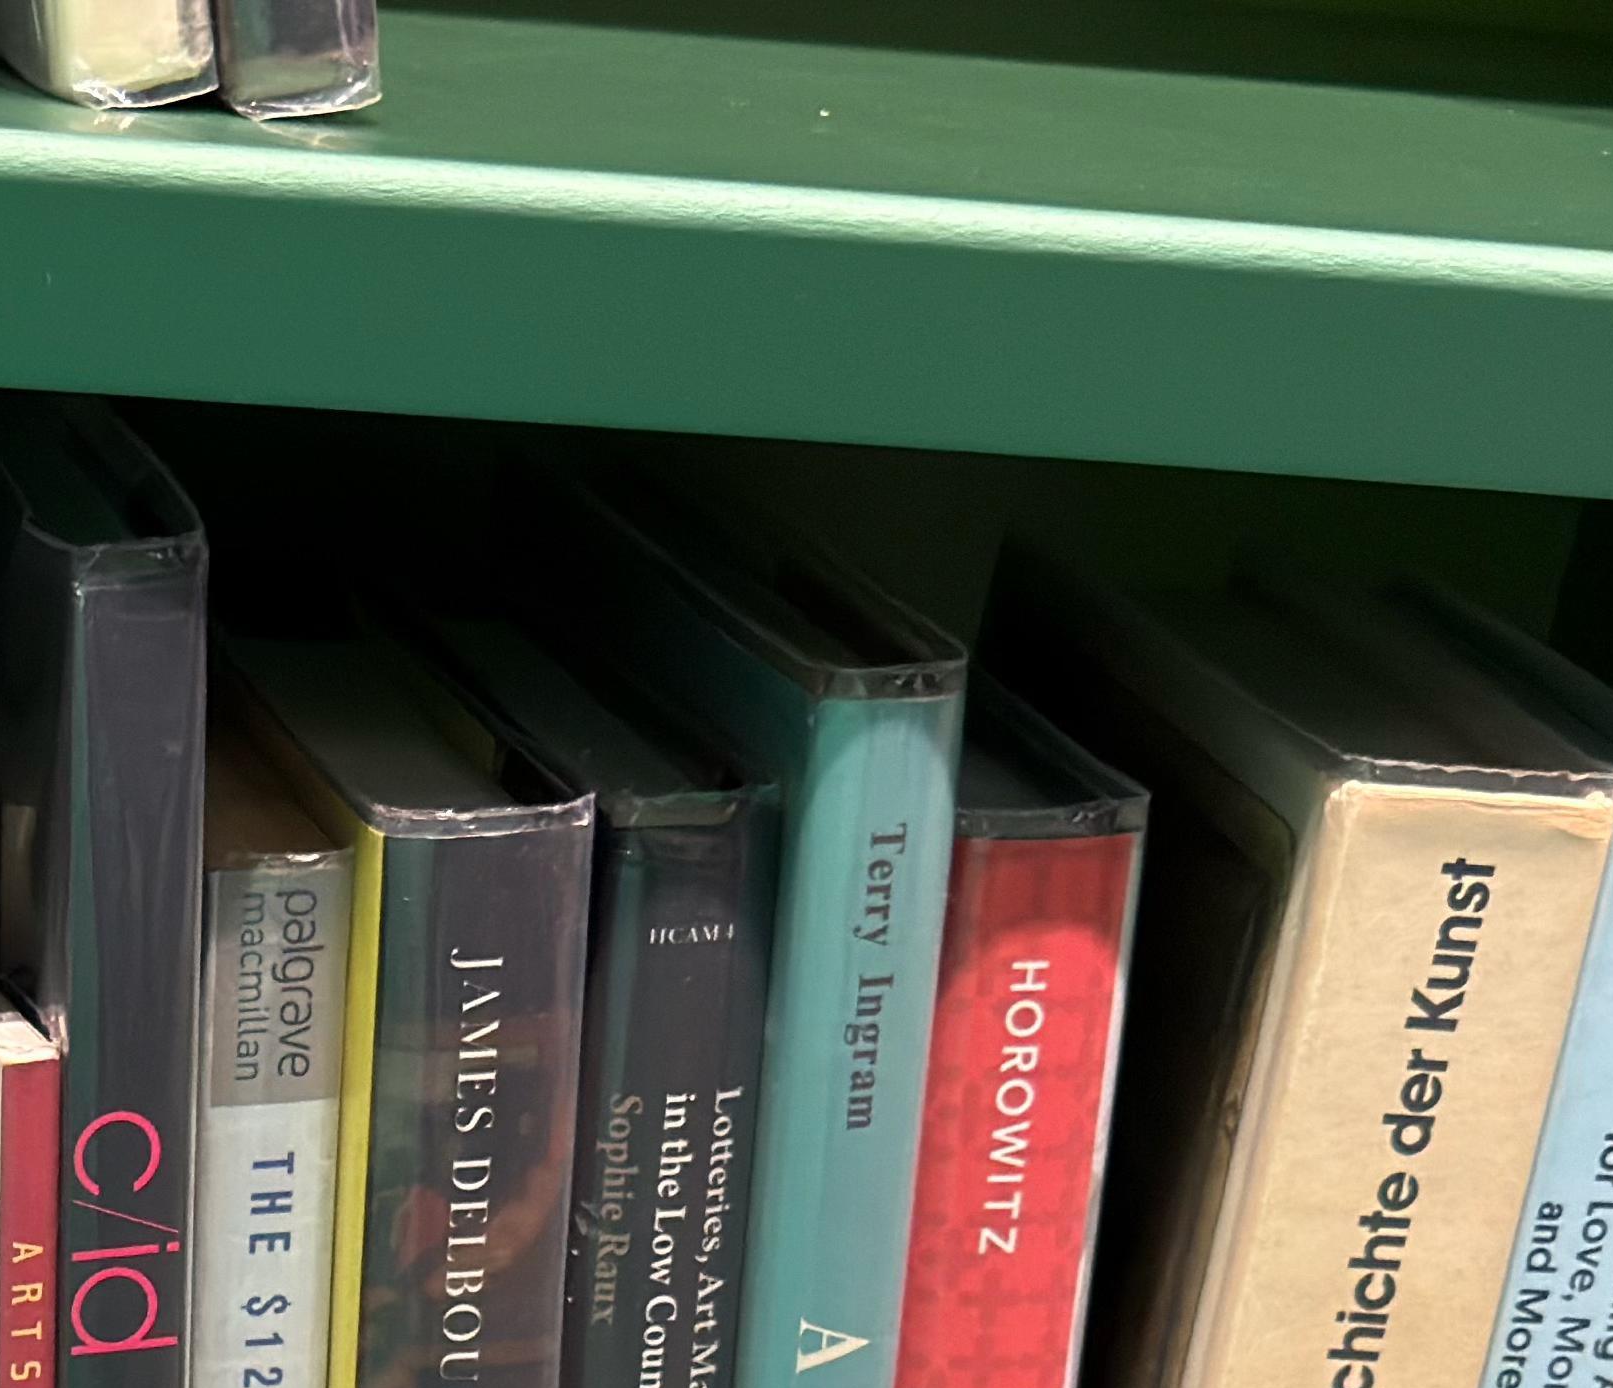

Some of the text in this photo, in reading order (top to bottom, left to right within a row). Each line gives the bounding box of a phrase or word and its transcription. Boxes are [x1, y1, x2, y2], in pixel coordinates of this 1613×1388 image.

[235, 892, 271, 1081] macmillan
[277, 888, 324, 1078] palgrave
[1404, 858, 1496, 1032] Kunst
[450, 948, 503, 1133] JAMES
[977, 959, 1049, 1256] HOROWITZ
[1382, 1049, 1450, 1156] der
[248, 1151, 295, 1255] THE
[696, 1084, 743, 1264] Lotteries,
[10, 1242, 44, 1381] ARTS
[240, 1294, 291, 1388] $12
[693, 1272, 725, 1334] Art
[797, 1316, 869, 1373] A
